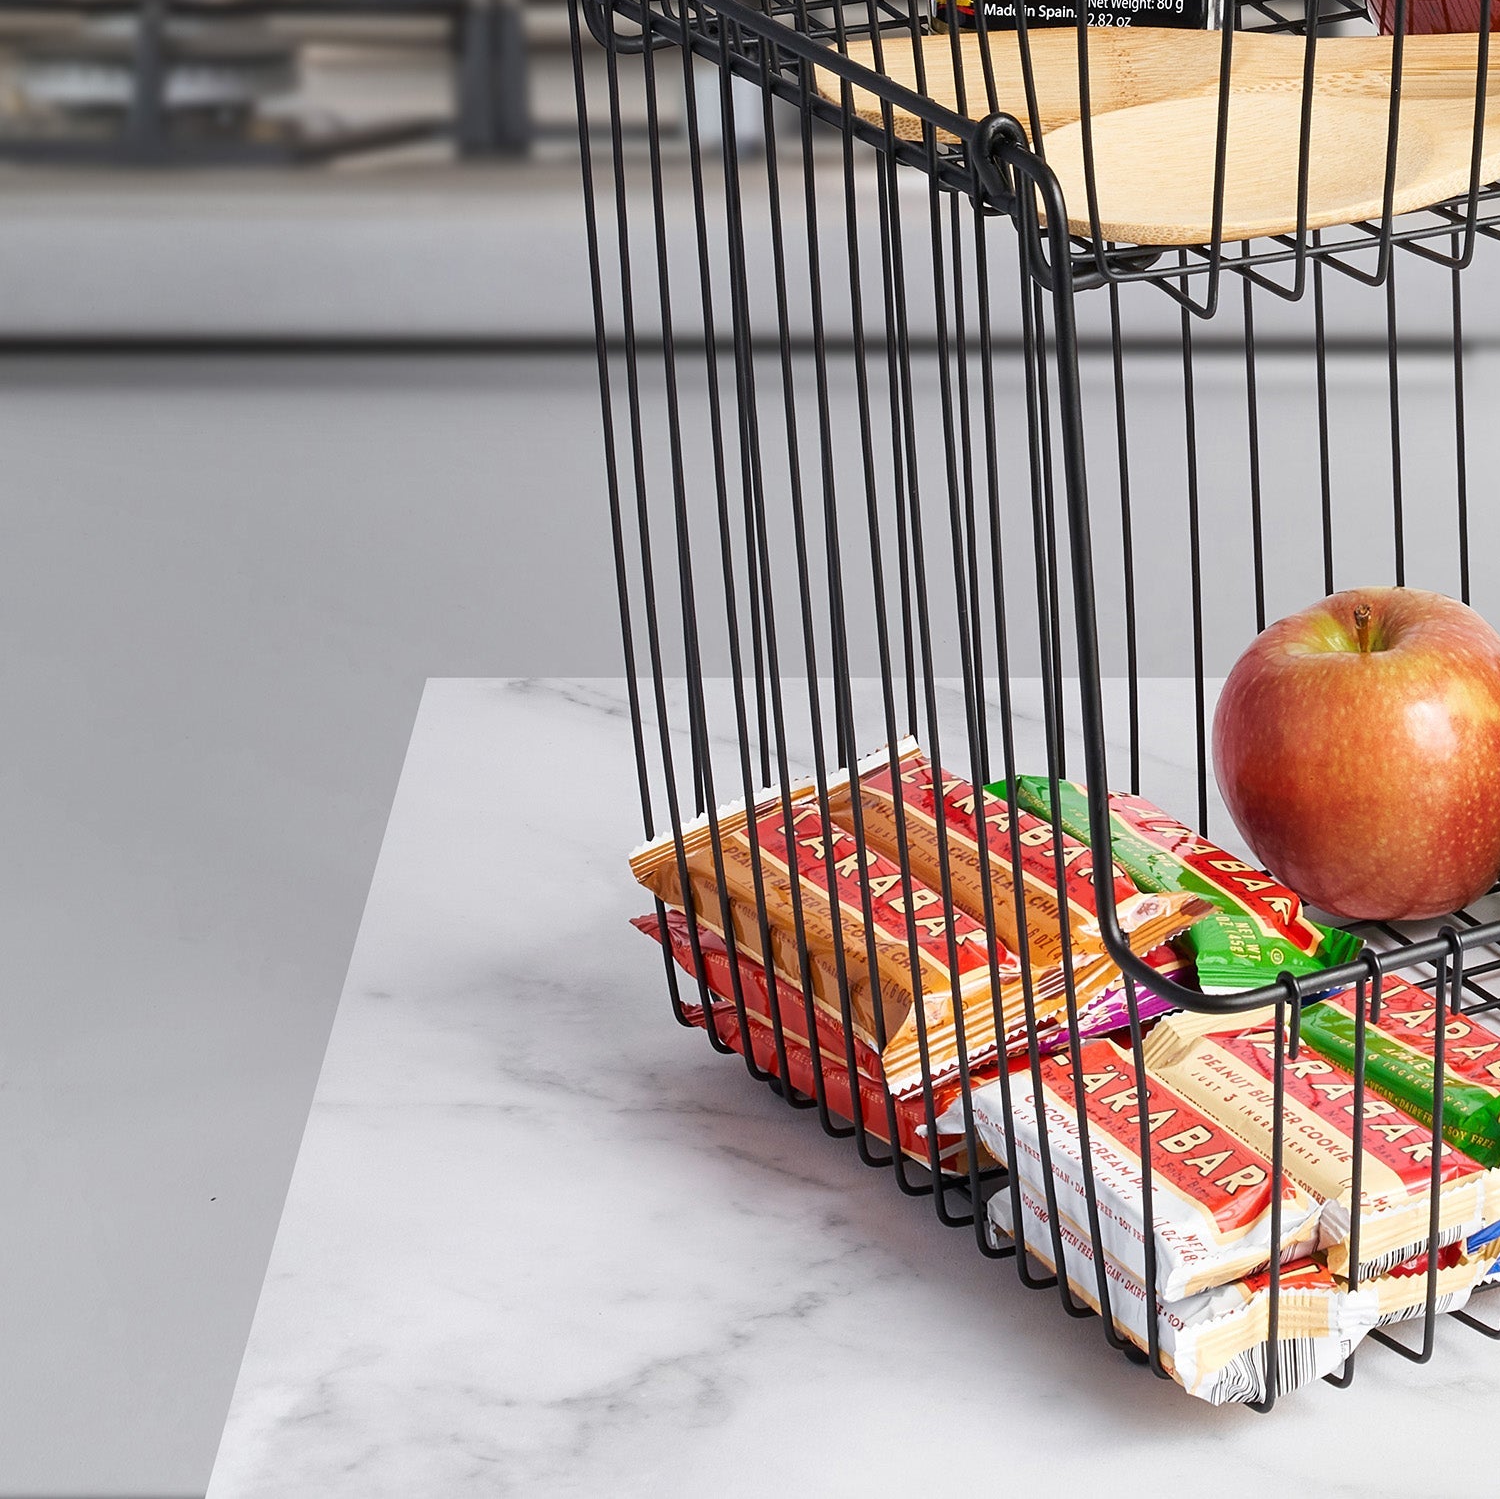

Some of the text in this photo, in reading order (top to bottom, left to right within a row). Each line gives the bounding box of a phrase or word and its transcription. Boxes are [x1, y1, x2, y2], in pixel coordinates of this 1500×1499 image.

[1024, 4, 1036, 17] in
[1038, 4, 1078, 20] Spain.
[1116, 16, 1132, 28] oz
[722, 845, 777, 880] PEAUT
[777, 876, 820, 913] BUTER
[891, 949, 928, 978] CHP
[1331, 1034, 1355, 1049] JUS
[1382, 1060, 1470, 1113] INGREDNTS
[1025, 1093, 1081, 1140] CCONUT
[1088, 1140, 1135, 1178] CREAM
[1191, 1072, 1321, 1166] JUST 3 INGREIENTS
[1197, 1053, 1253, 1090] PEANUT
[1299, 1124, 1354, 1164] COOKIE
[1447, 1124, 1467, 1142] SOY
[1471, 1132, 1497, 1150] FREE
[1051, 1161, 1070, 1186] EGAN
[1053, 1139, 1134, 1200] INGRDIENTS
[1103, 1261, 1122, 1283] EGAN
[1124, 1279, 1148, 1303] DAIRY
